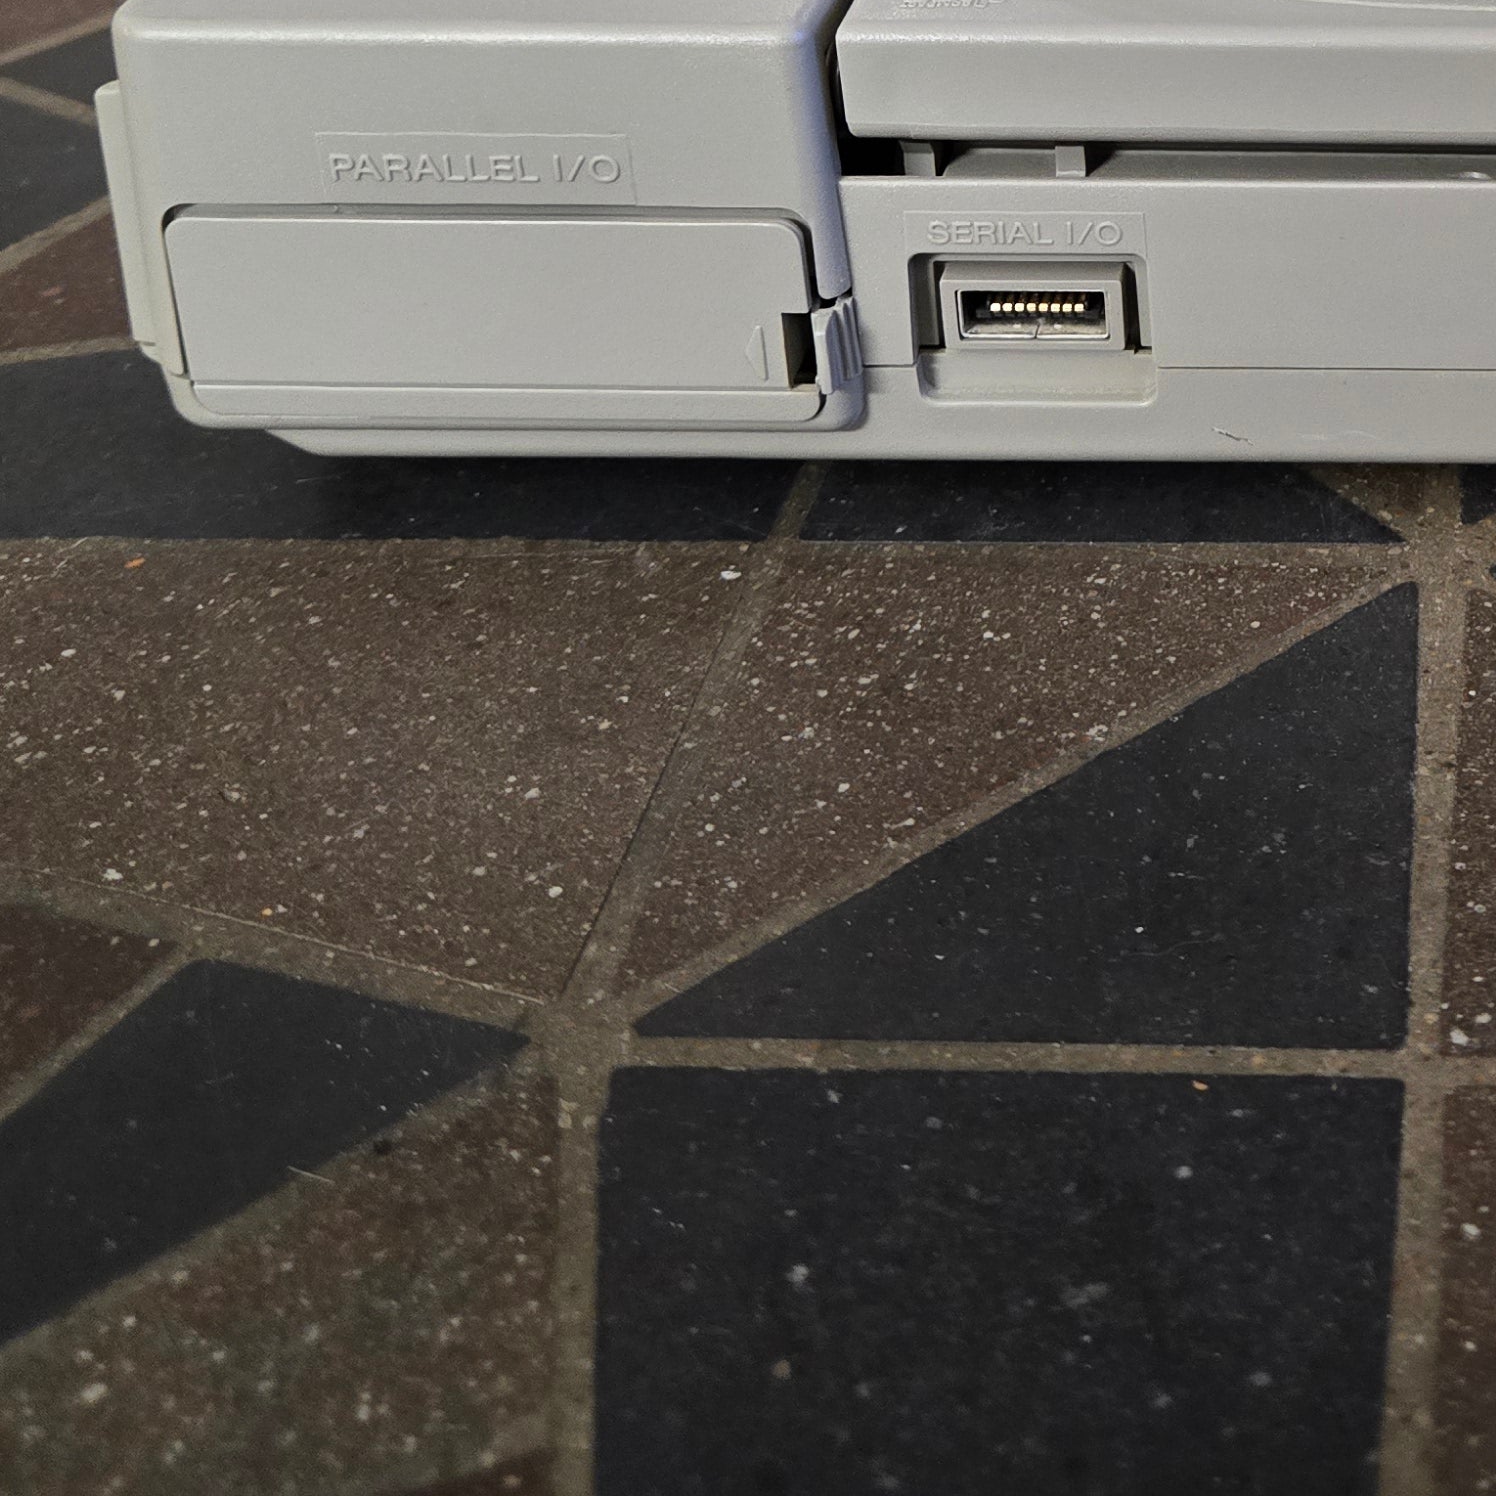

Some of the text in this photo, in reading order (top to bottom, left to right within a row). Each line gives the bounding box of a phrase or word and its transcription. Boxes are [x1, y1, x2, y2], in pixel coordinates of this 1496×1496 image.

[328, 153, 622, 184] PARALLEL I/O
[927, 219, 1124, 246] SERIAL I/O
